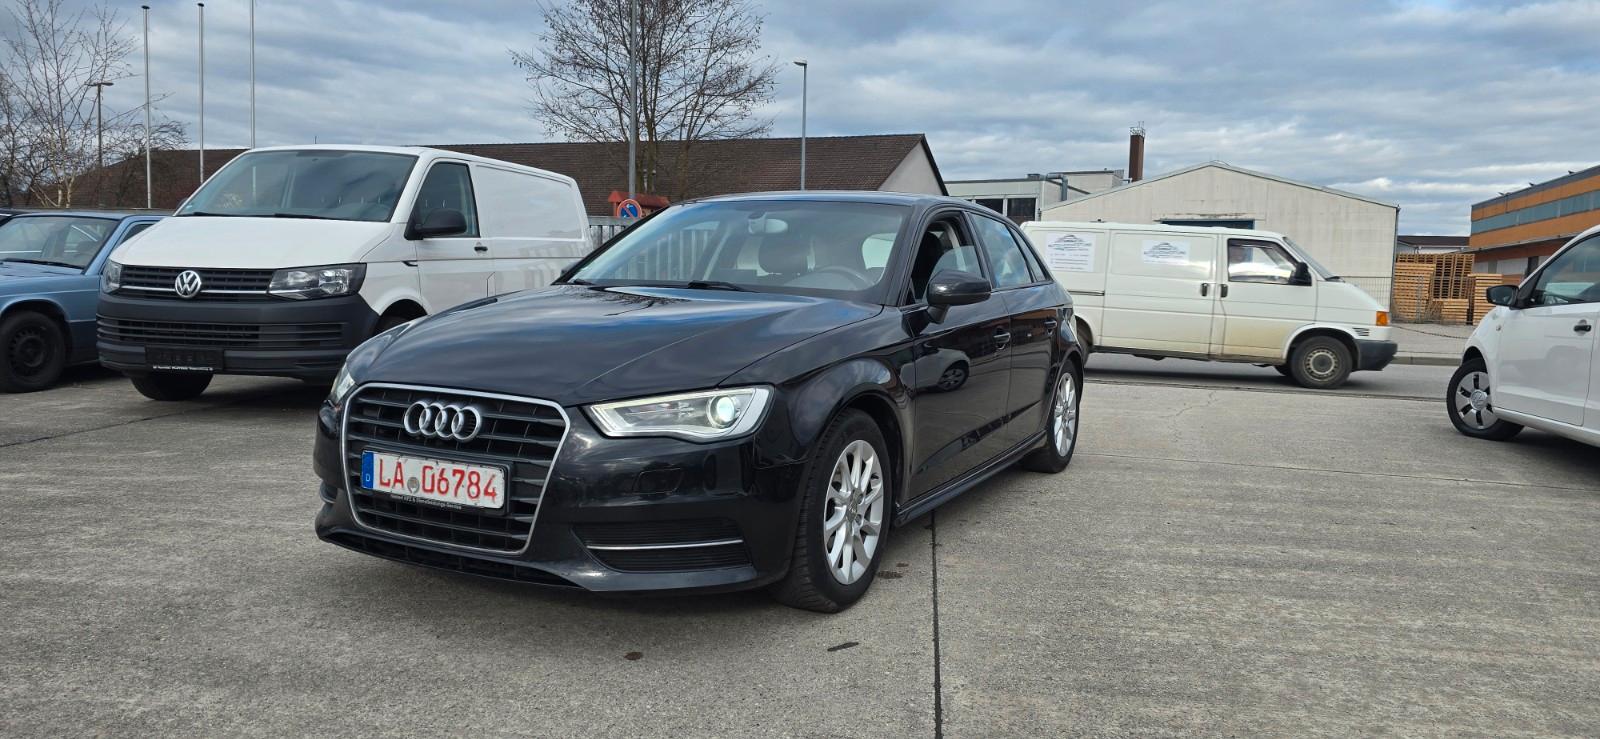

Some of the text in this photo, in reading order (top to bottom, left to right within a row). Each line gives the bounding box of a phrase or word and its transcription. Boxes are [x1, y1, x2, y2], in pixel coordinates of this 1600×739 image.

[175, 270, 201, 298] VW
[365, 473, 371, 482] D
[379, 458, 497, 503] LA 06784
